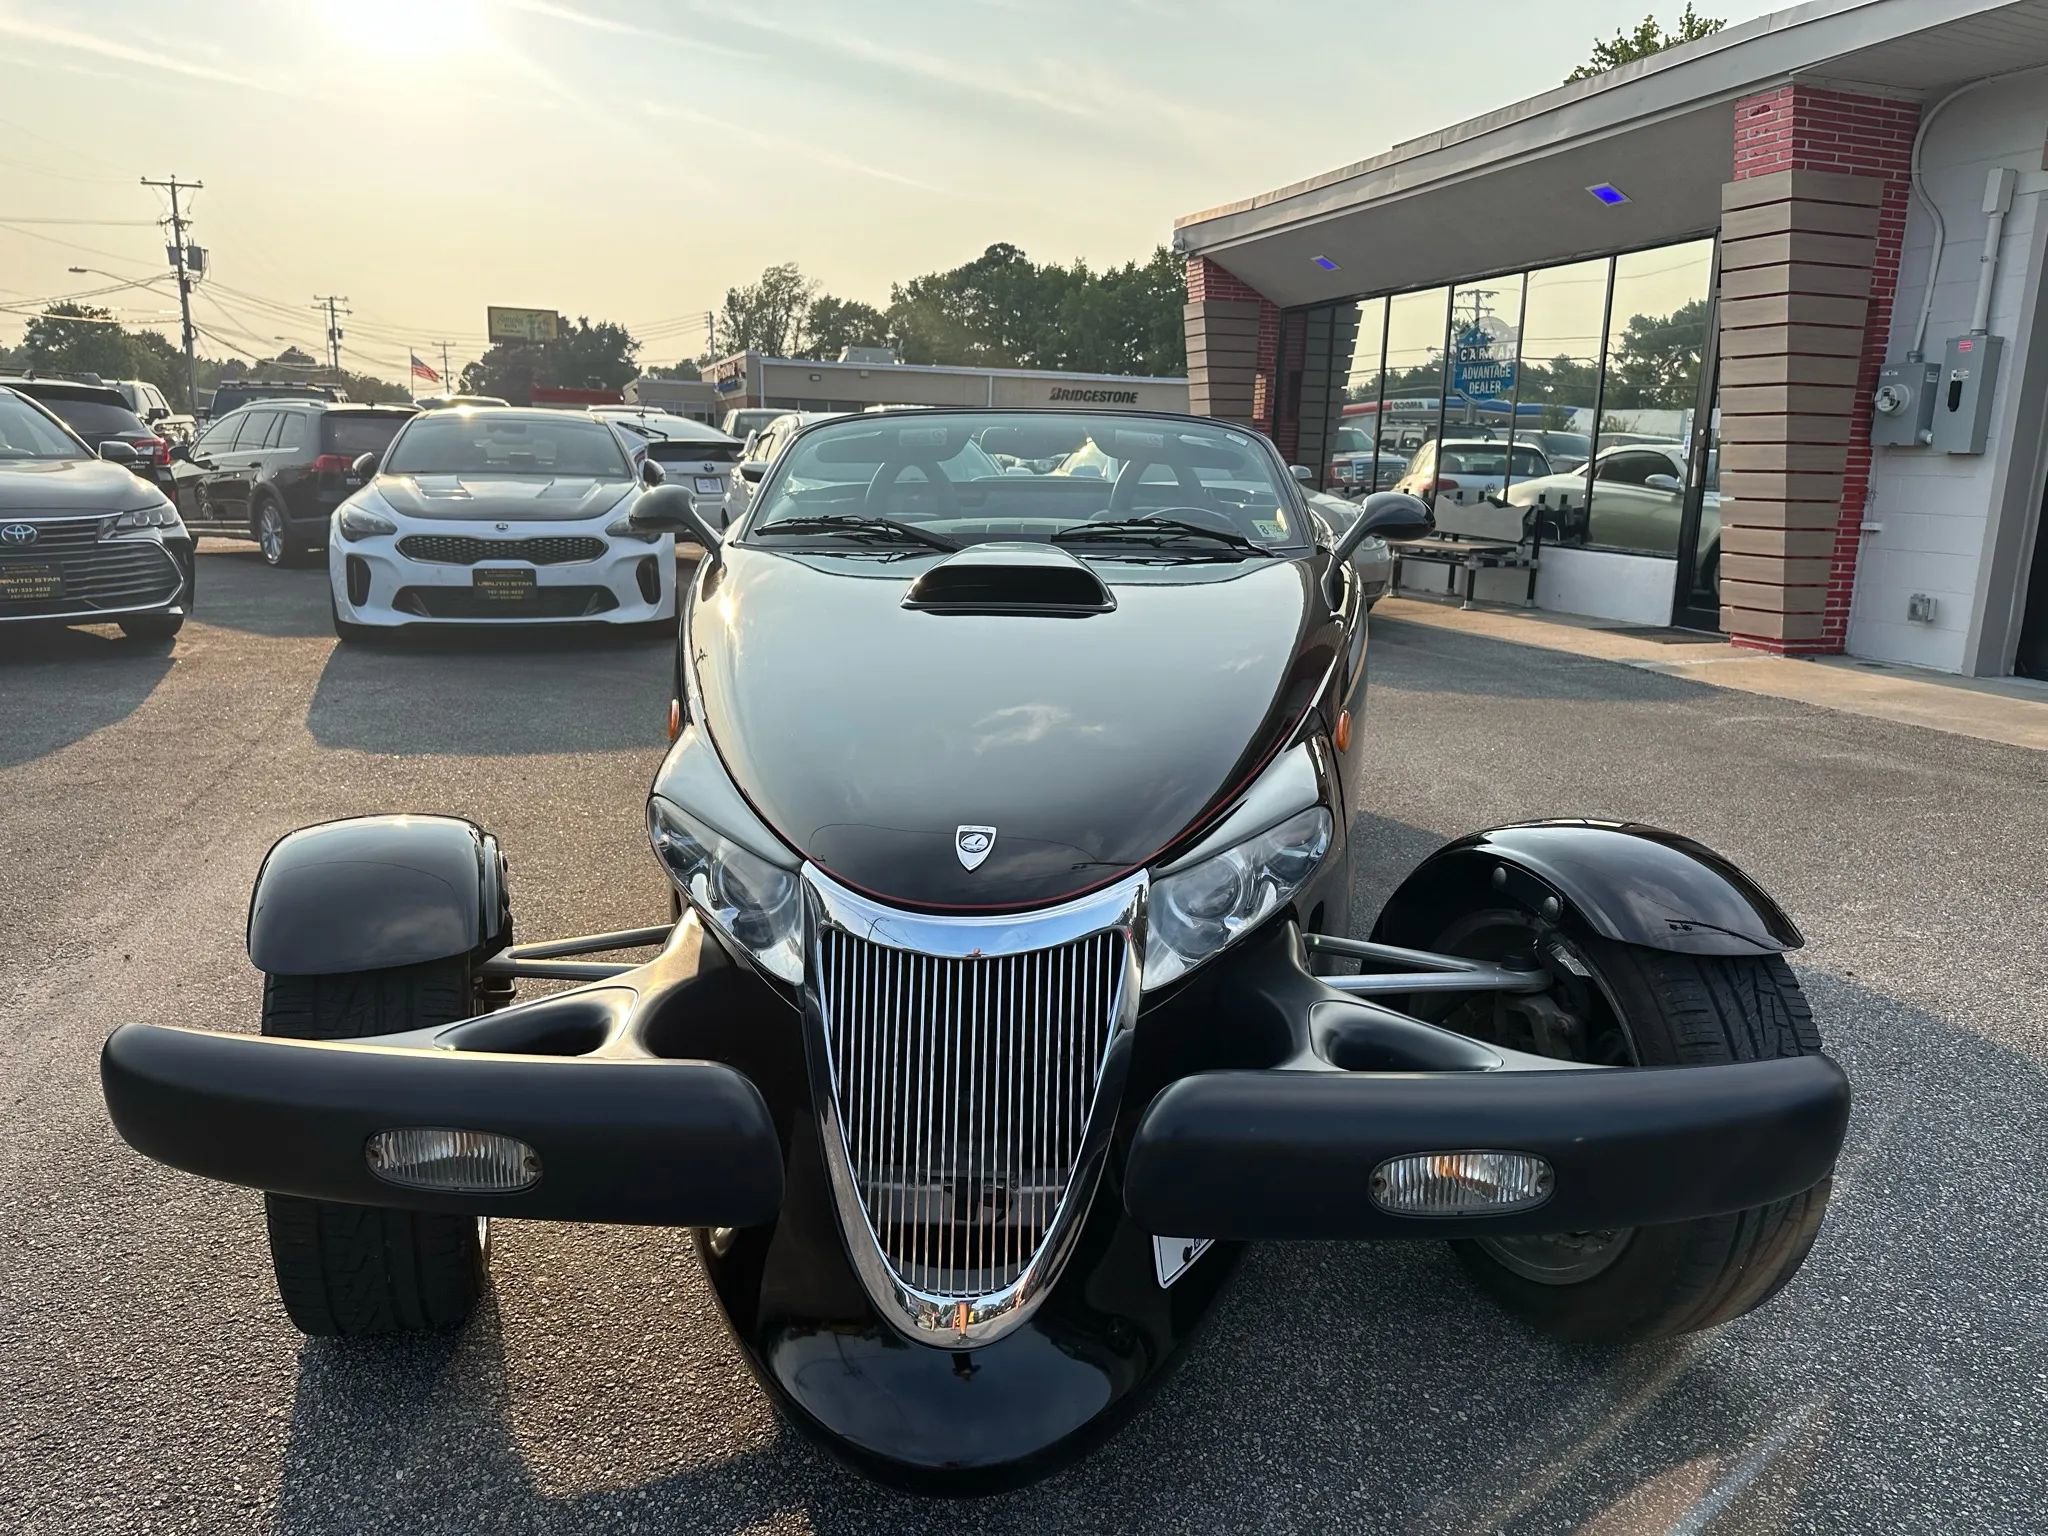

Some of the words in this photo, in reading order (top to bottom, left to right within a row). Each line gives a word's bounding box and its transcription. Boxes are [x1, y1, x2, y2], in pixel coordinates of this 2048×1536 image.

[1460, 343, 1515, 361] CARFAX
[1462, 365, 1511, 380] ADVANTAGE
[1049, 387, 1138, 404] BRIDGESTONE
[1468, 381, 1501, 395] DEALER
[1260, 524, 1270, 535] 8
